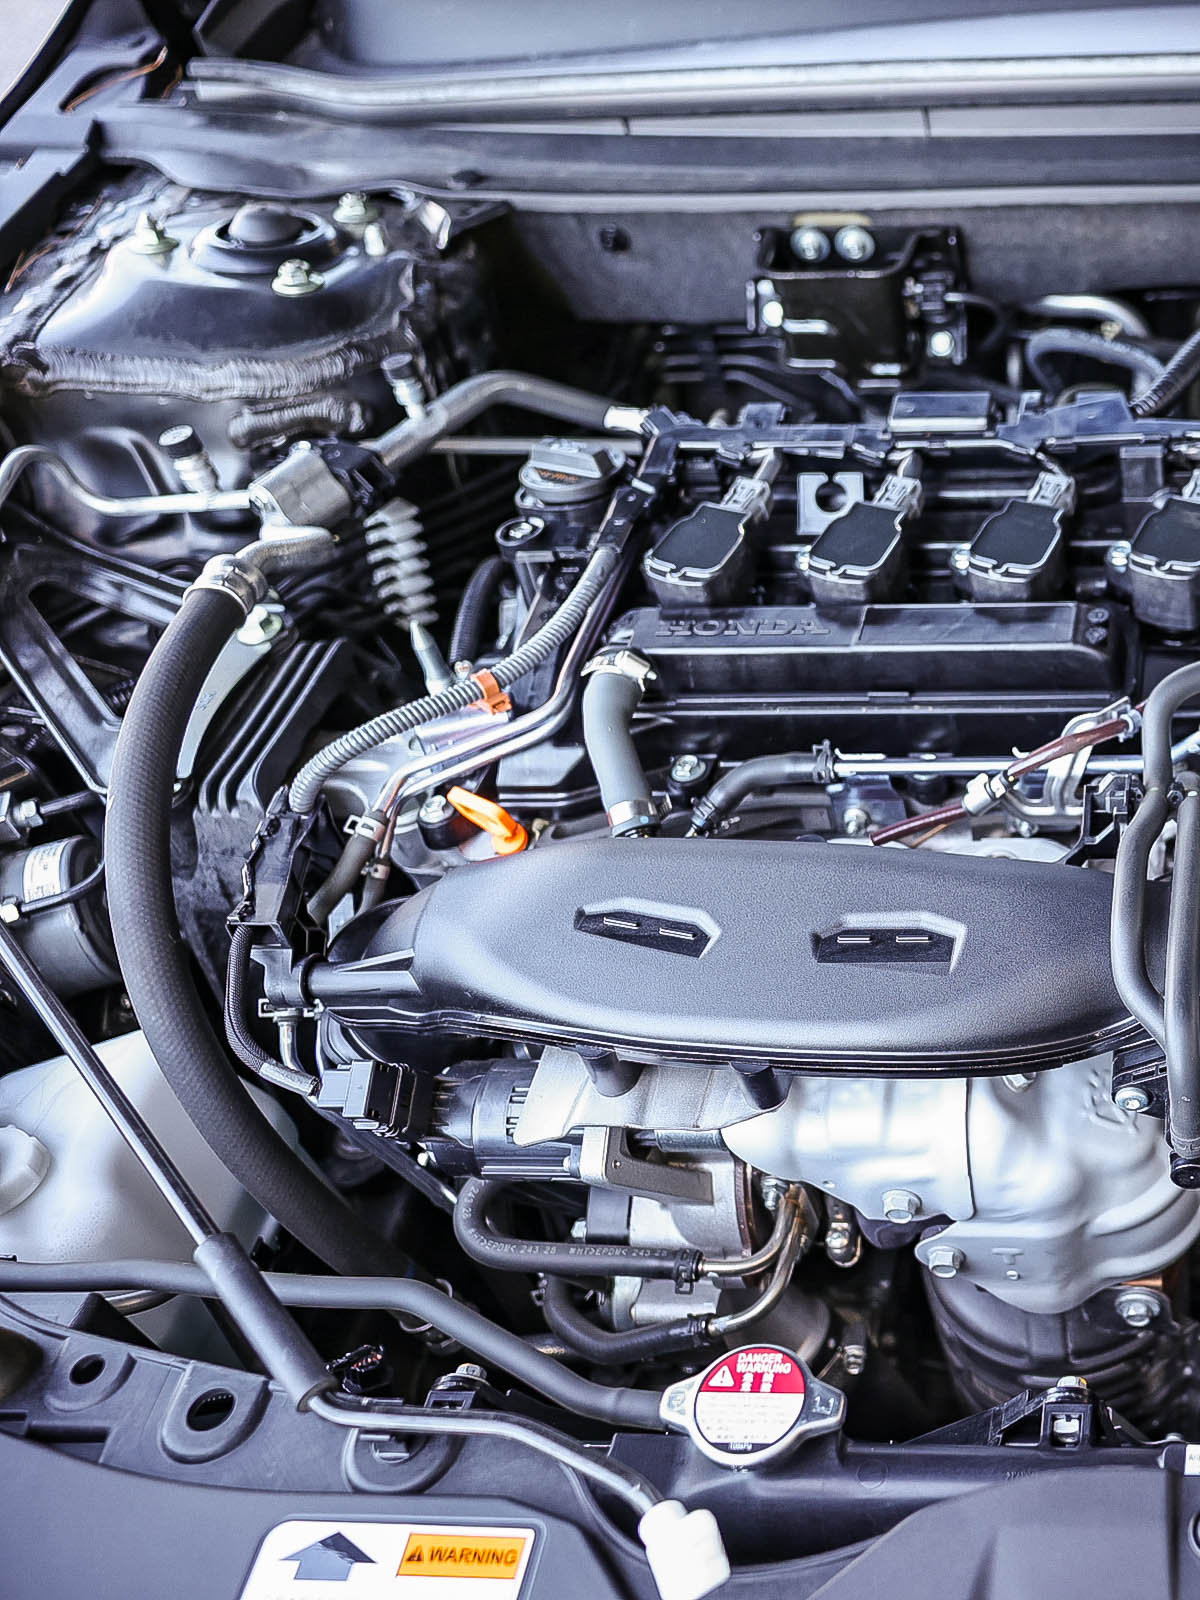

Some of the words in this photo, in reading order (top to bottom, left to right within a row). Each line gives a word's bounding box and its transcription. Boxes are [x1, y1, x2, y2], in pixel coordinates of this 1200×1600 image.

[655, 619, 831, 637] HONDA
[737, 1352, 784, 1363] DANGER
[430, 1545, 518, 1566] WARNING
